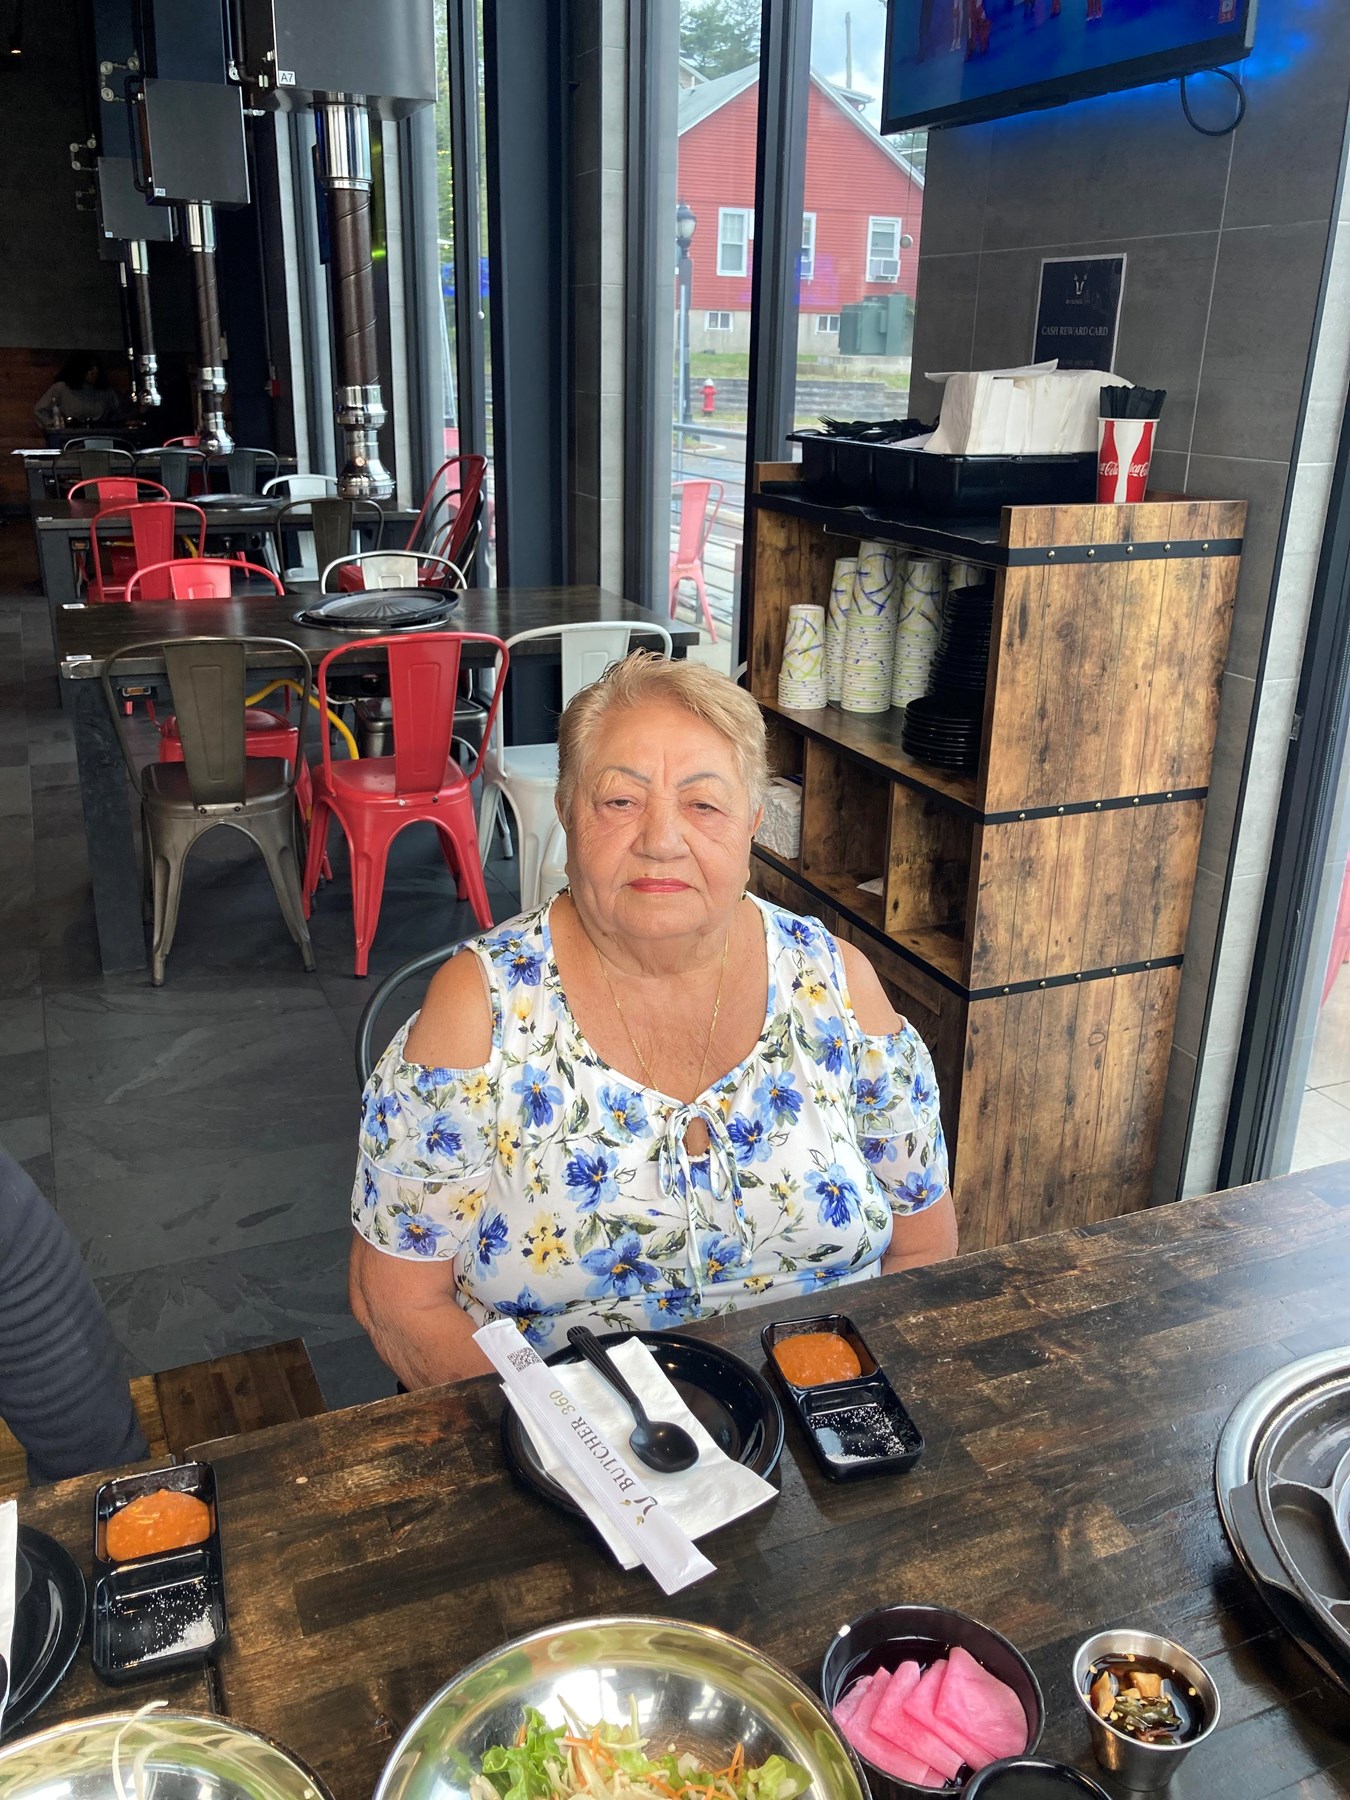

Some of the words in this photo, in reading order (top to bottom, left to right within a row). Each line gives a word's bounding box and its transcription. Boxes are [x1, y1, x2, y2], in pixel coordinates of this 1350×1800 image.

[281, 72, 293, 82] A7
[1041, 326, 1059, 335] CASH
[1059, 326, 1088, 336] REWARD
[1088, 326, 1109, 336] CARD
[549, 1390, 576, 1415] 360
[570, 1416, 636, 1492] BUTCHER
